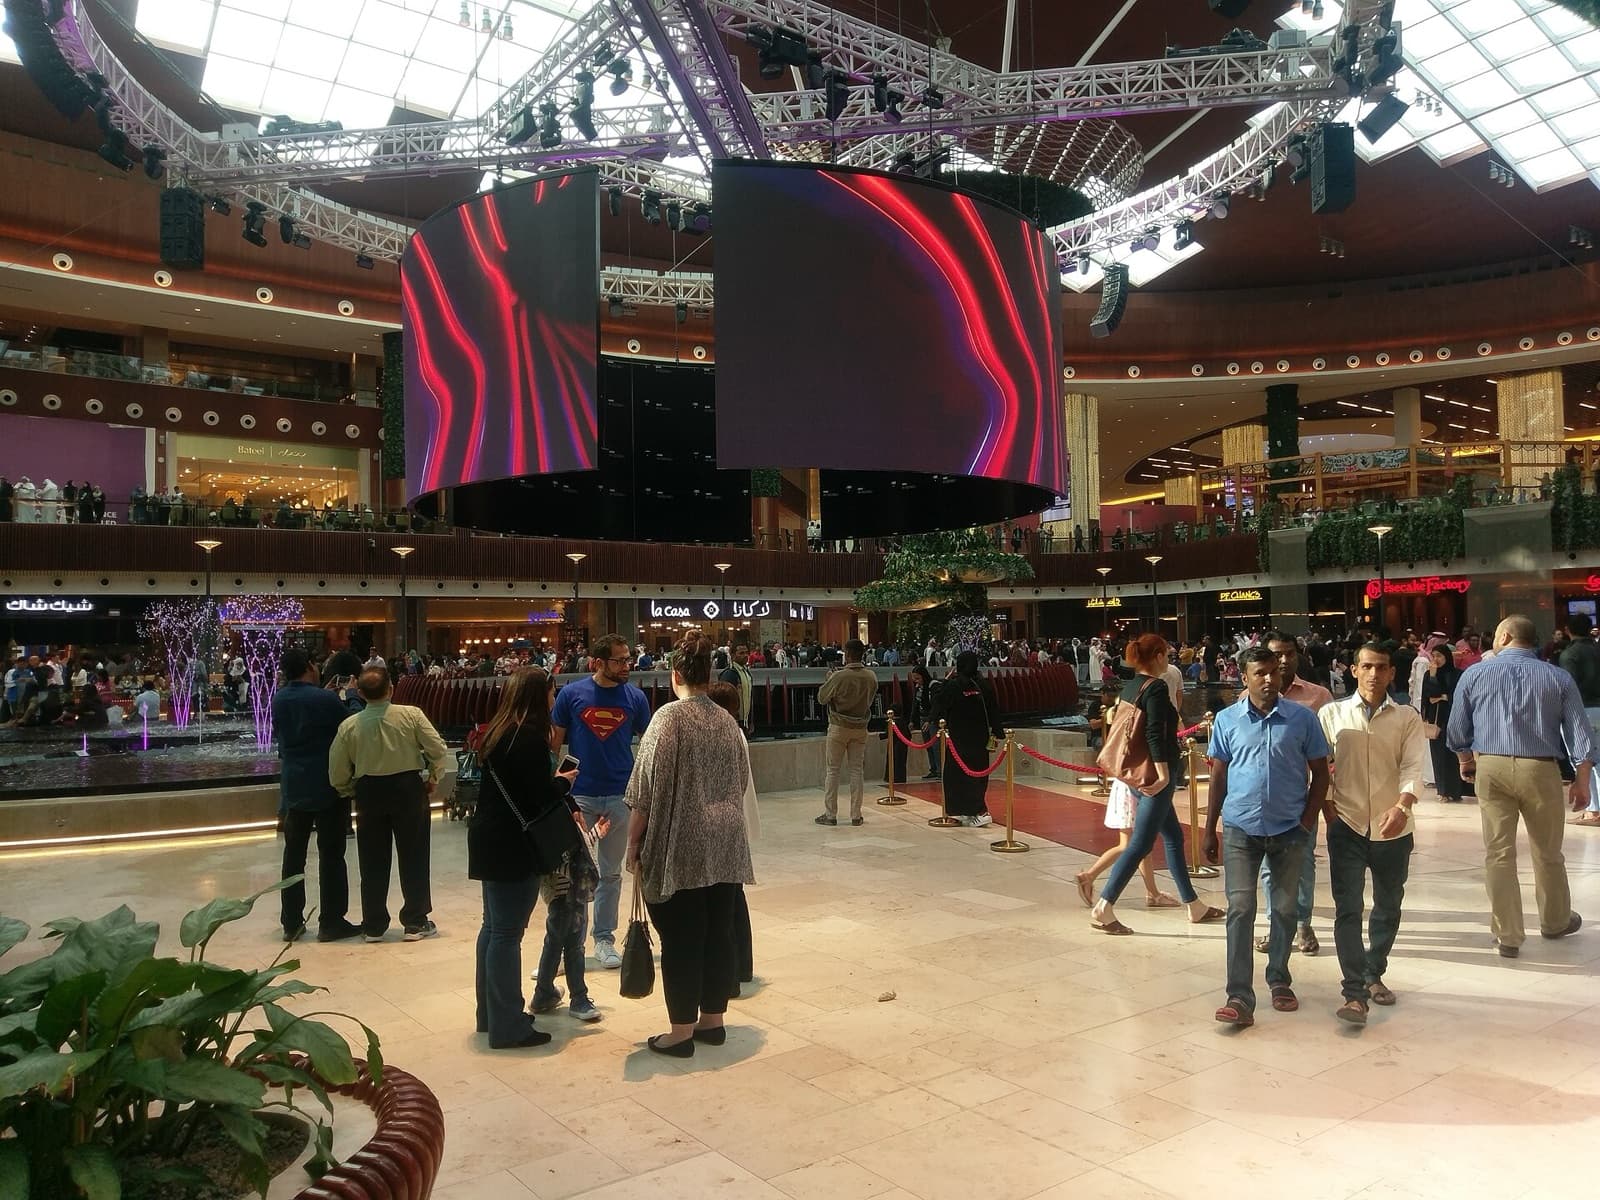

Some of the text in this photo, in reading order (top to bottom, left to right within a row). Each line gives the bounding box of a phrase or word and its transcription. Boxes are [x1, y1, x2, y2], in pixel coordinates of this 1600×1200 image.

[1366, 576, 1472, 599] Chesecake Factory
[6, 598, 93, 613] شيك شاك
[651, 599, 691, 618] la casa
